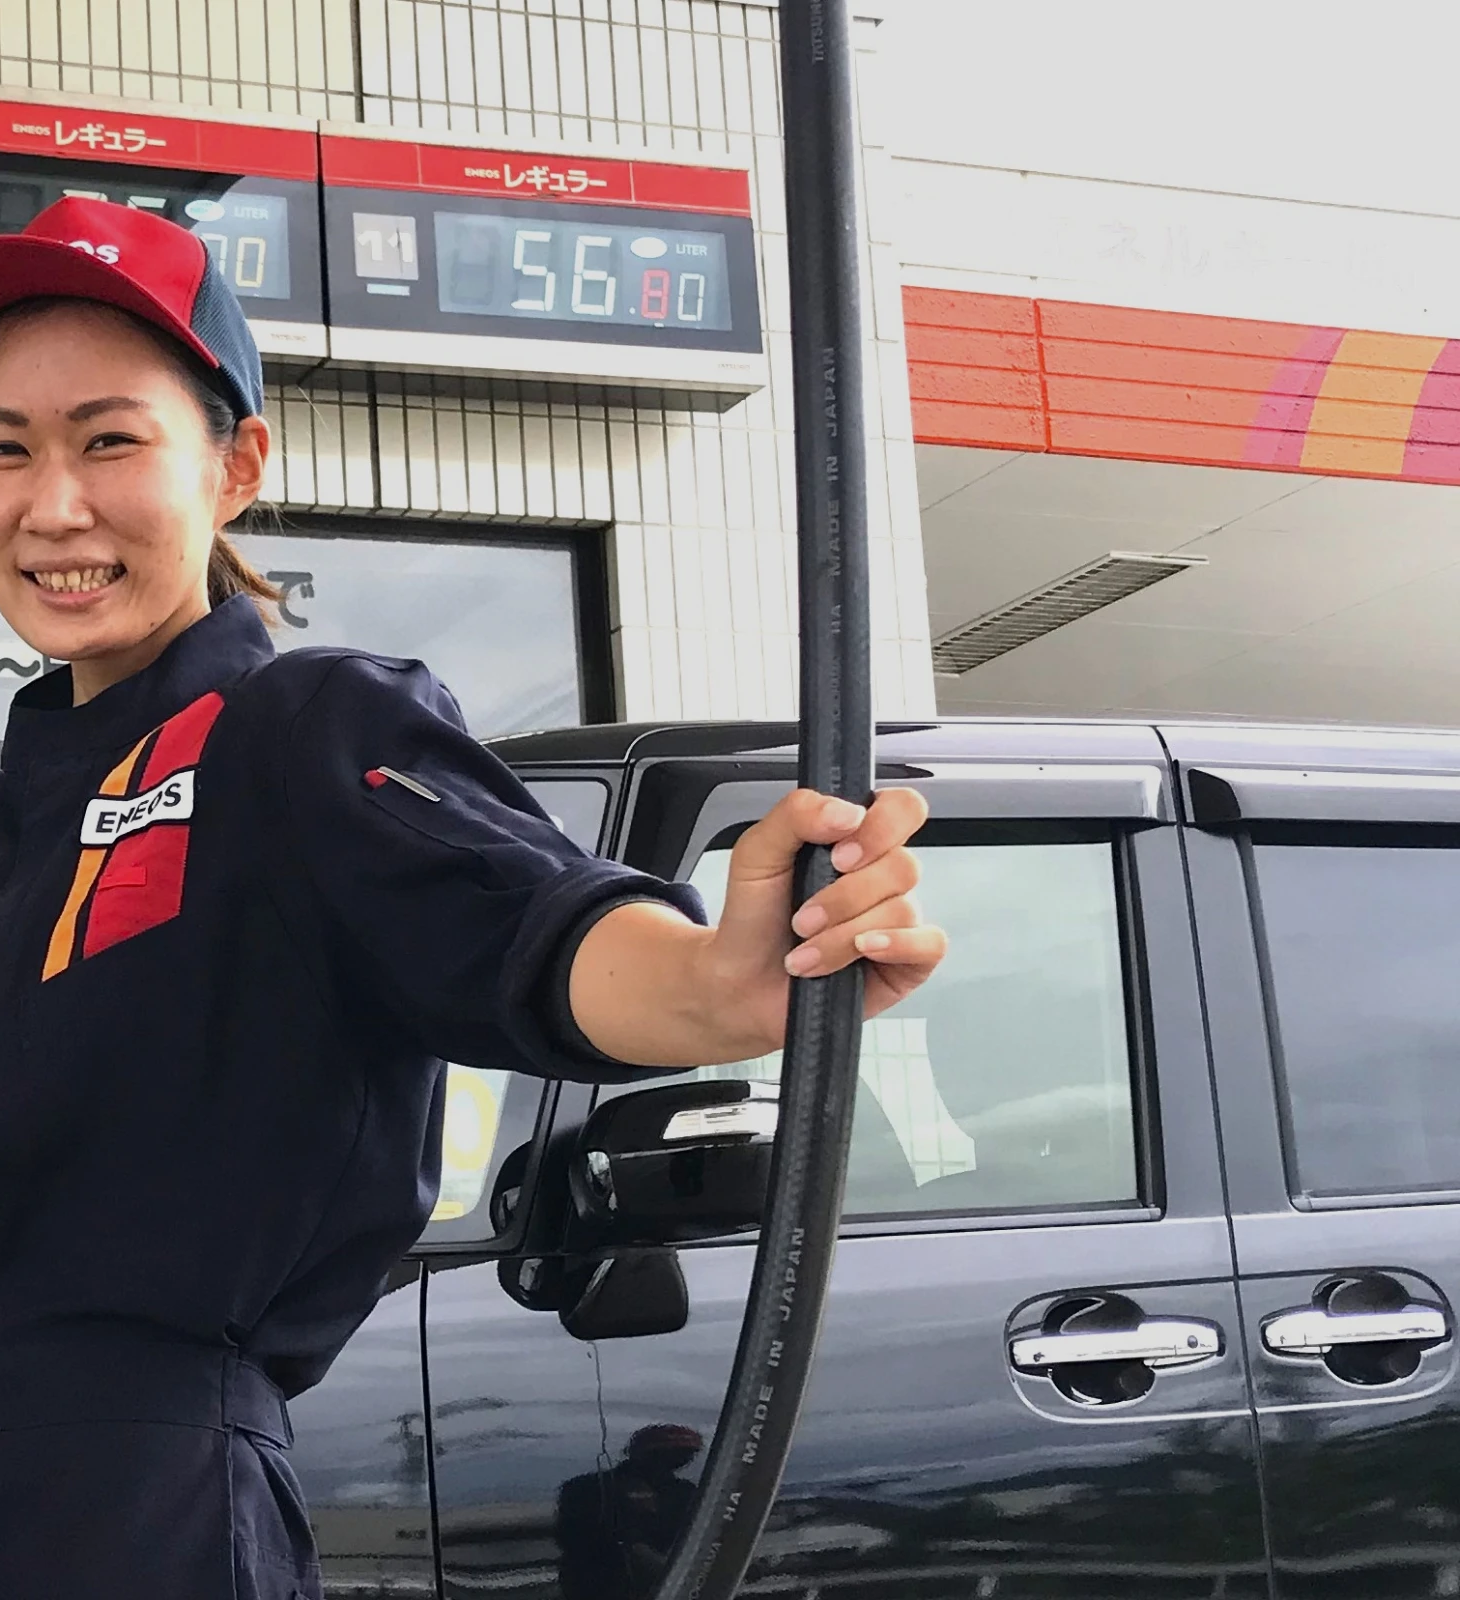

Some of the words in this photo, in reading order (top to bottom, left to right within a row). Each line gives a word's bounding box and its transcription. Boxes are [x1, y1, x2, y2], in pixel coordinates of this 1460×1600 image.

[12, 123, 50, 136] ENEOS
[54, 121, 167, 152] レギュラー
[465, 167, 500, 180] ENEOS
[504, 164, 608, 194] レギュラー
[234, 206, 269, 220] LITER
[357, 229, 414, 263] 11
[676, 243, 708, 256] LITER
[824, 345, 837, 438] JAPAN
[827, 455, 839, 482] IN
[828, 500, 841, 577] MADE
[95, 782, 182, 834] ENEOS
[723, 1490, 744, 1522] HA
[741, 1382, 775, 1465] MADE
[767, 1339, 784, 1368] IN
[780, 1226, 805, 1321] JAPAN
